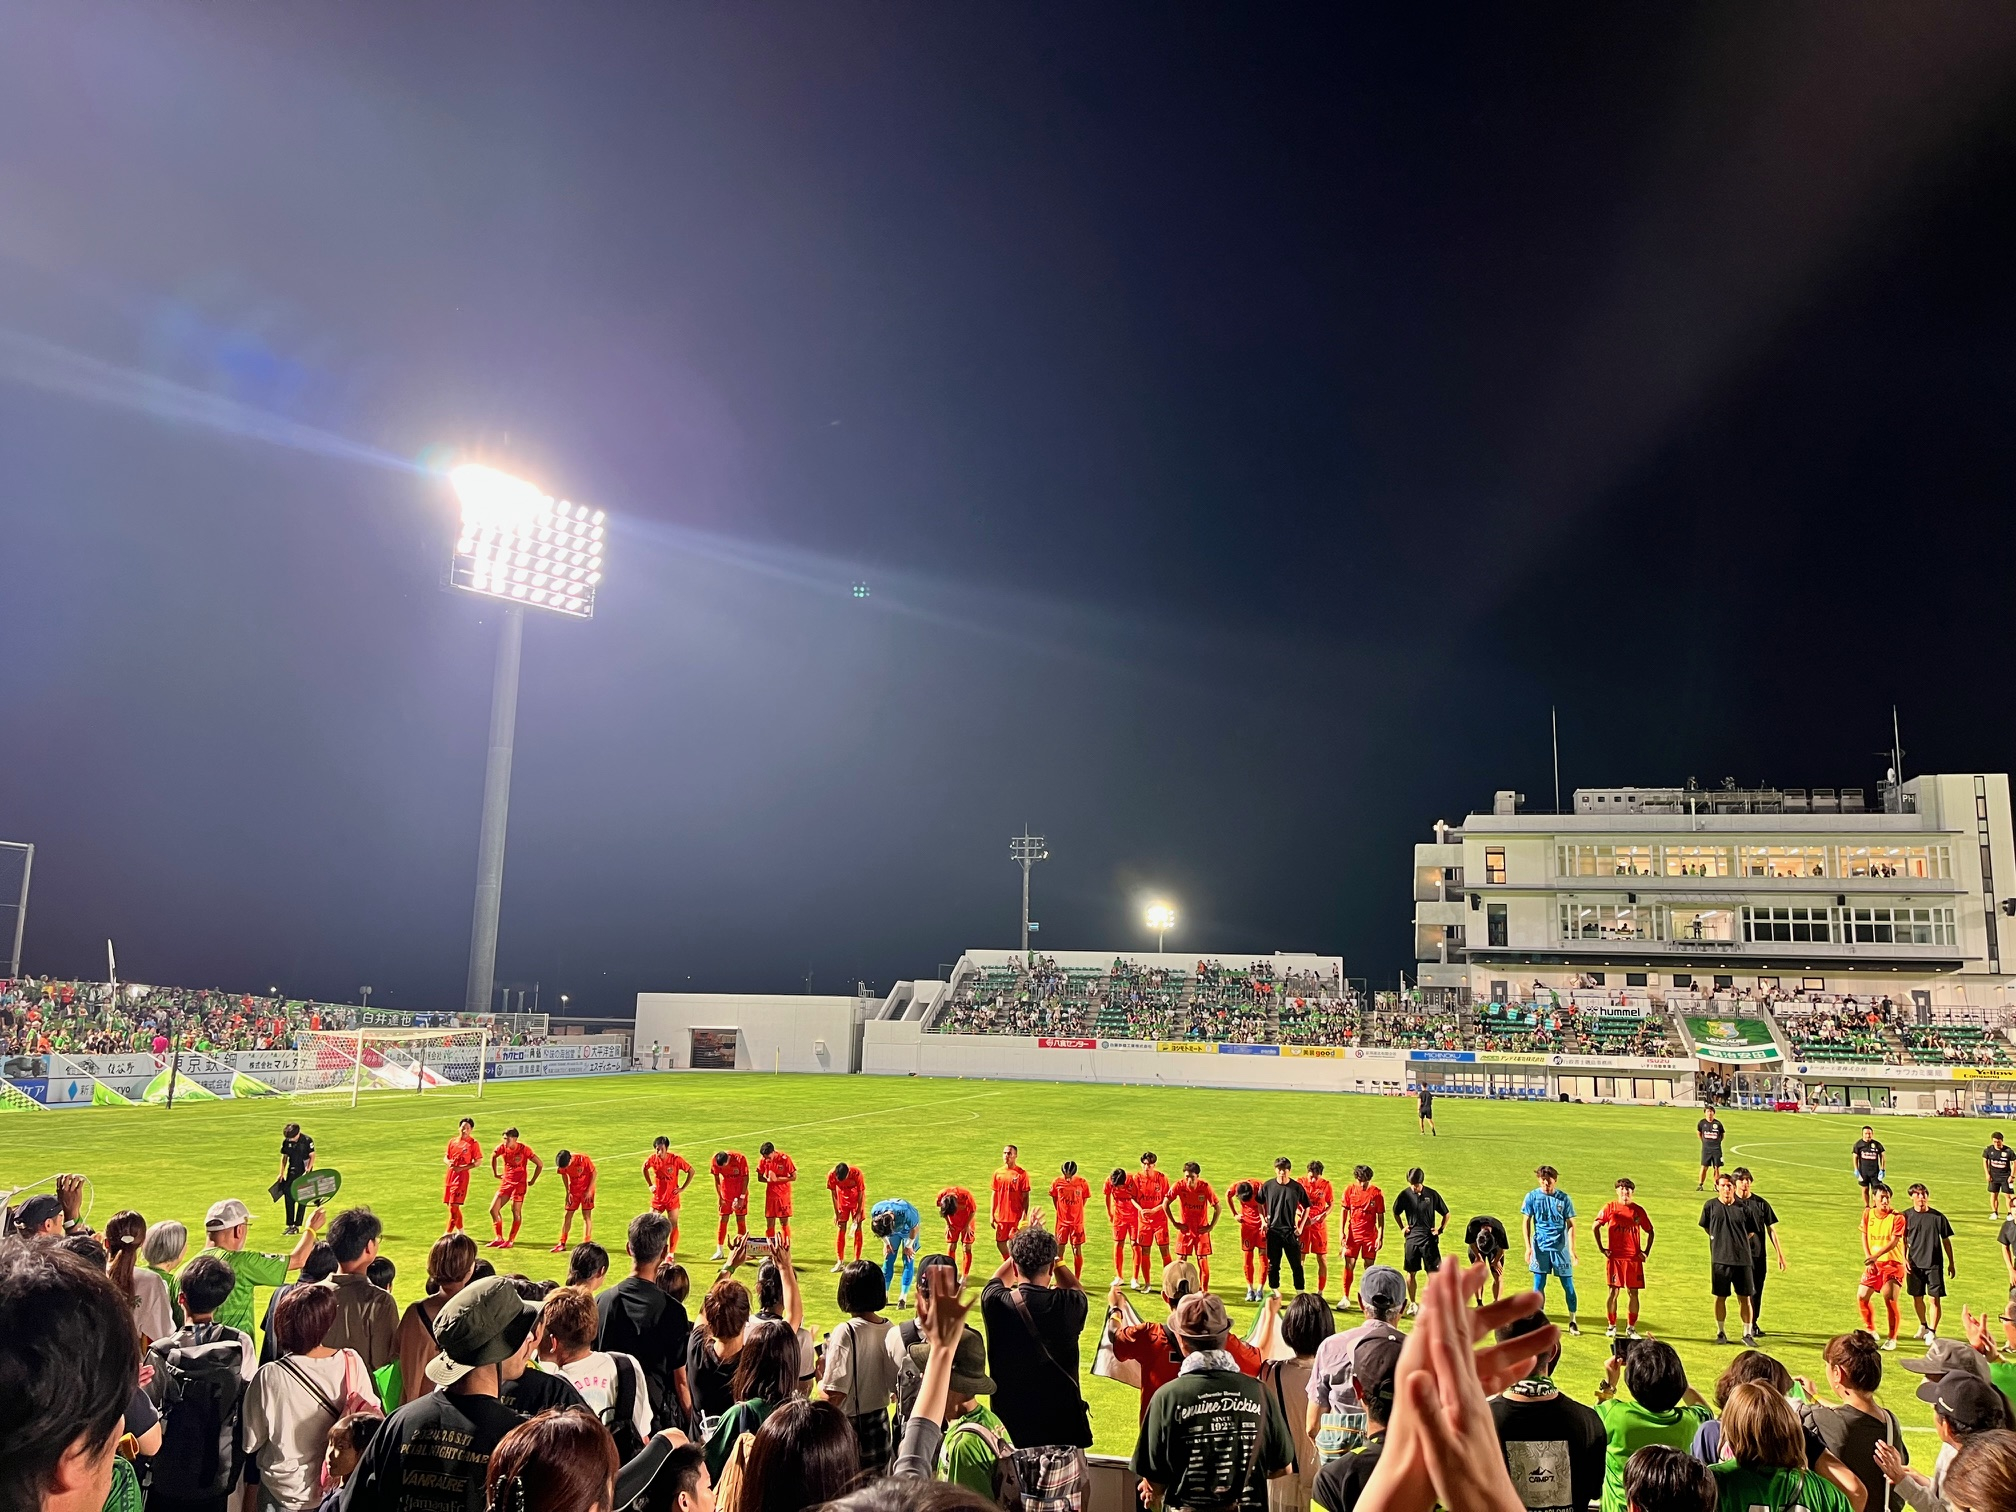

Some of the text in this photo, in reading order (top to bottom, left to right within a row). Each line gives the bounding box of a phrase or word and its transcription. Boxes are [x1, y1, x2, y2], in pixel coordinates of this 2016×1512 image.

[1902, 794, 1915, 803] PH
[1599, 1006, 1641, 1017] hummel
[1708, 1049, 1767, 1059] 明治安田
[402, 1469, 469, 1493] VANRAURE
